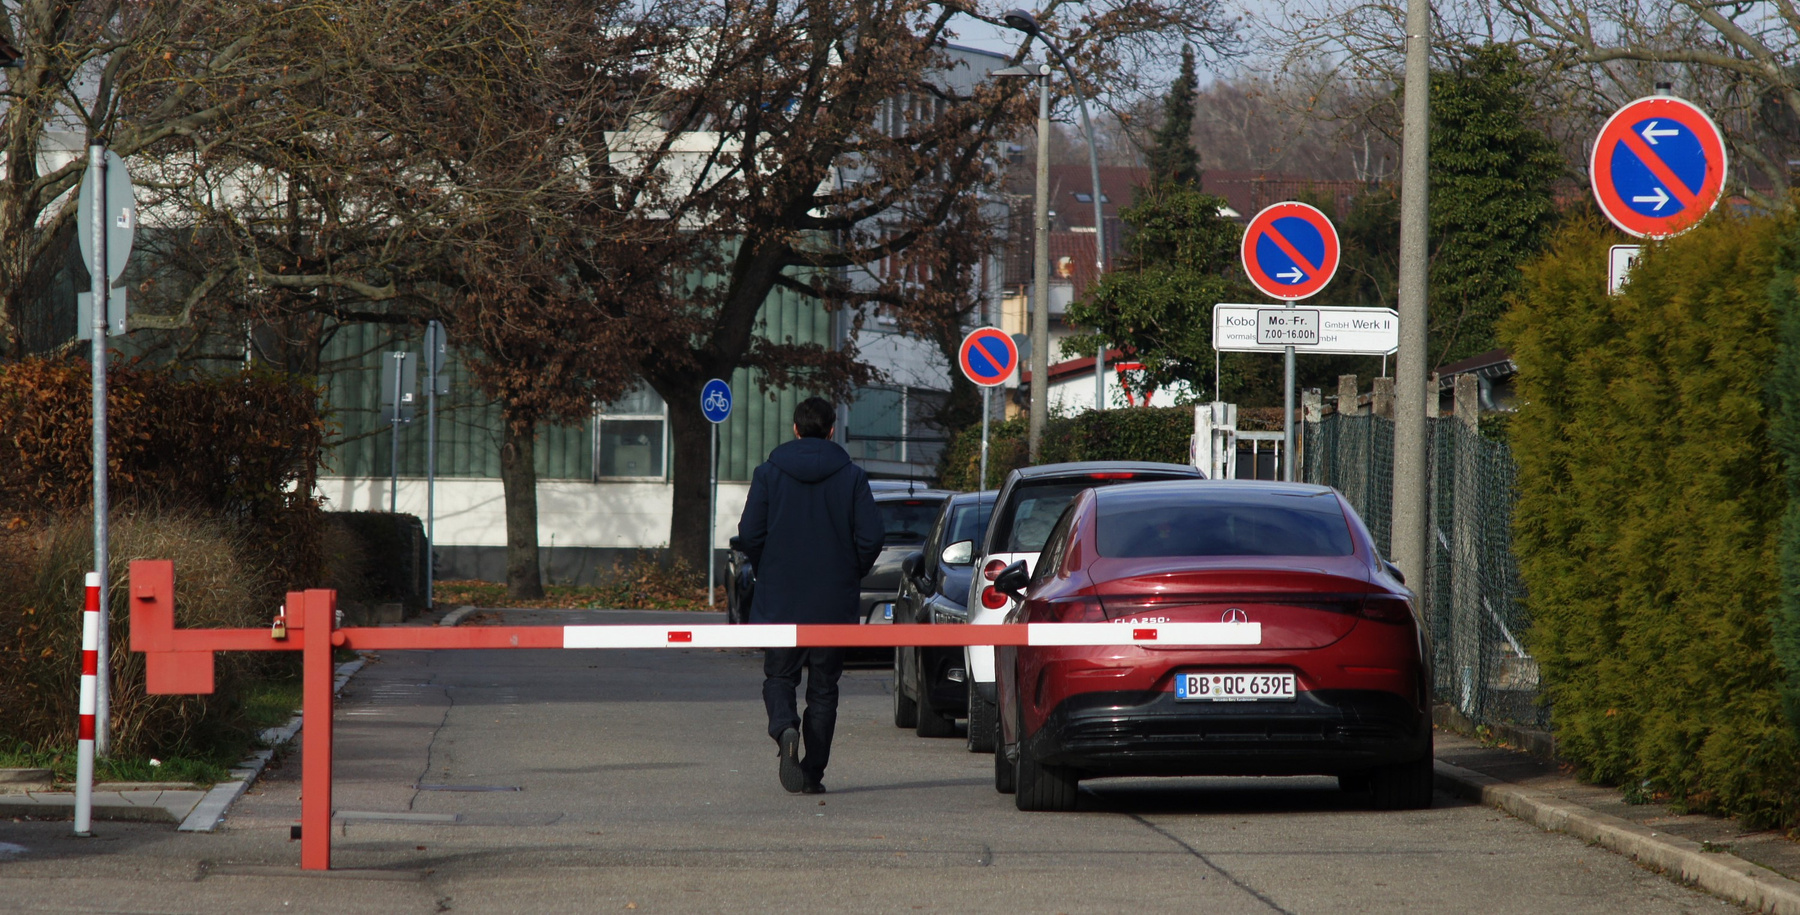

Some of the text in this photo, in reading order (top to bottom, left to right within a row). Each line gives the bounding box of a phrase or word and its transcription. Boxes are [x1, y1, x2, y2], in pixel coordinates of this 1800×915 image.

[1268, 316, 1308, 326] Mo.-Fr.
[1325, 321, 1350, 329] GmbH
[1352, 319, 1380, 330] Werk
[1384, 320, 1390, 329] II
[1265, 330, 1315, 339] 7.00-16.00h
[1188, 677, 1210, 695] BB
[1223, 677, 1245, 694] QC
[1250, 676, 1293, 694] 639E
